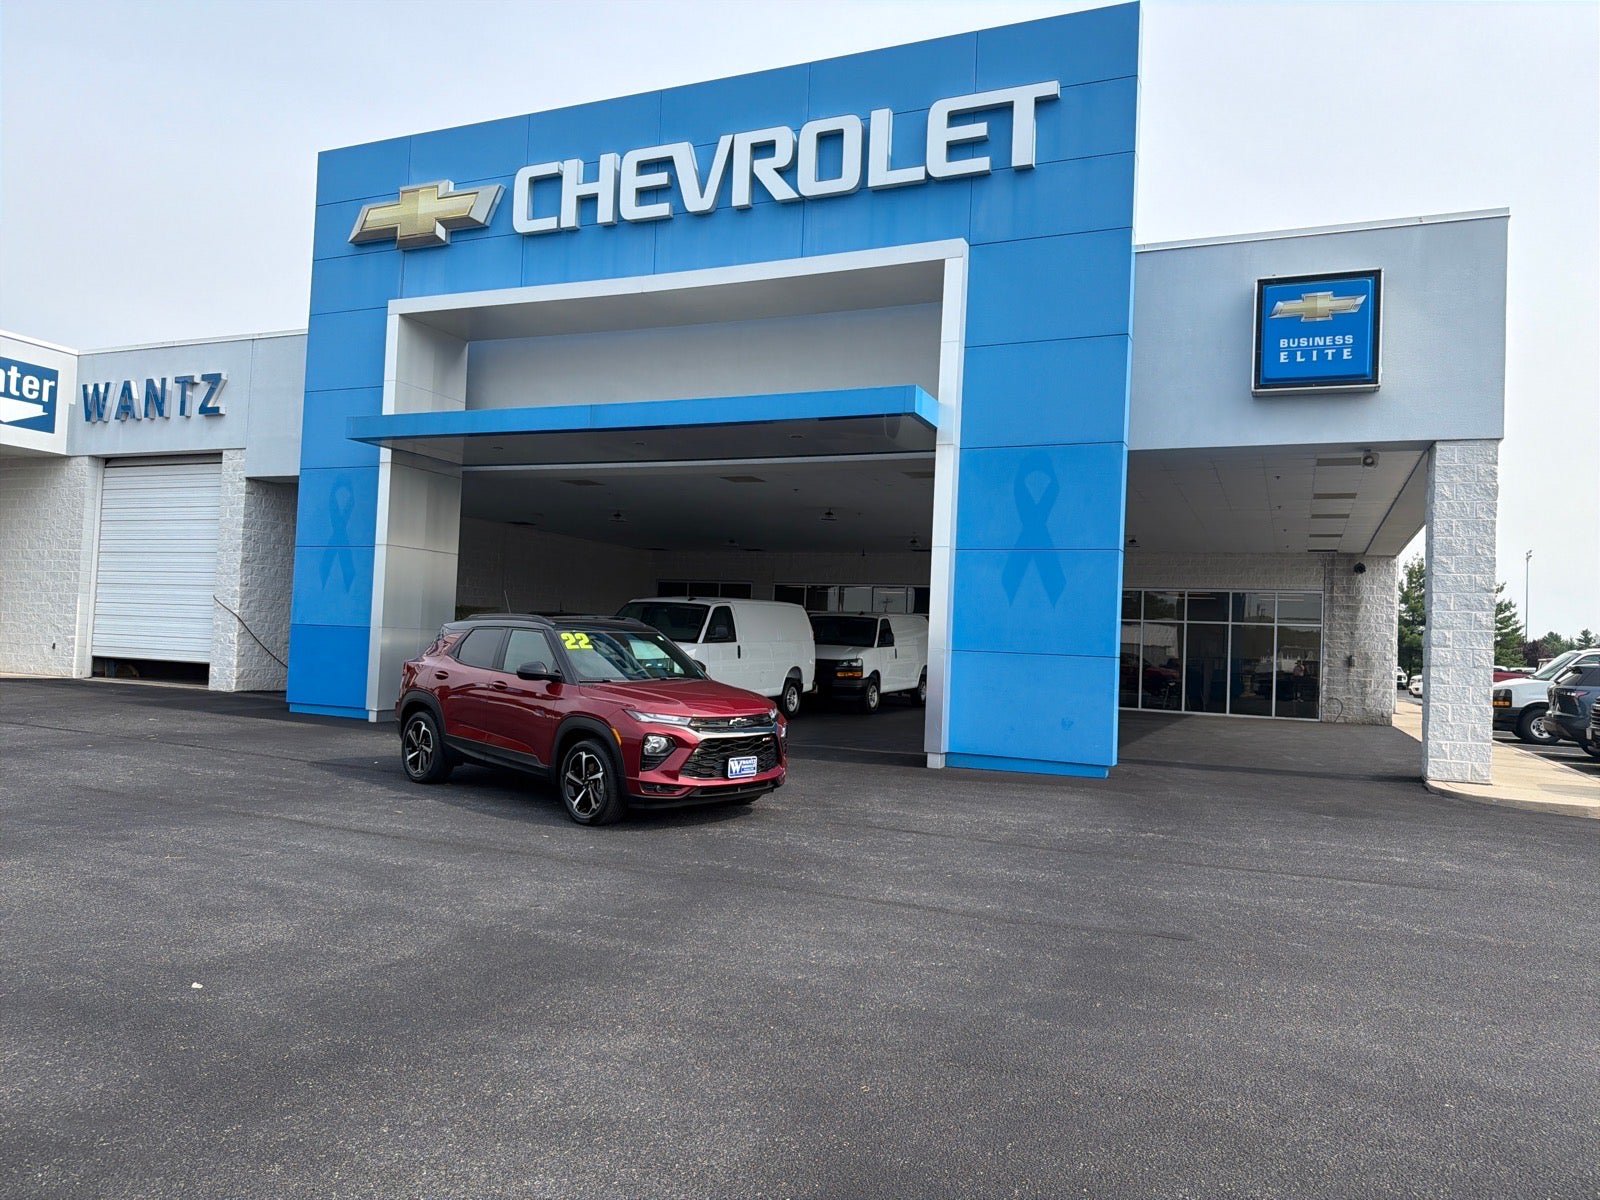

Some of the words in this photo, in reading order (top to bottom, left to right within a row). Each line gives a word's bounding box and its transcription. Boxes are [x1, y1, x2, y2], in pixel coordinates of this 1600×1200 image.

[512, 80, 1060, 235] CHEVROLET
[1279, 335, 1354, 348] BUSINESS
[1279, 348, 1353, 363] ELITE
[82, 372, 228, 423] WANTZ
[560, 632, 594, 650] 22
